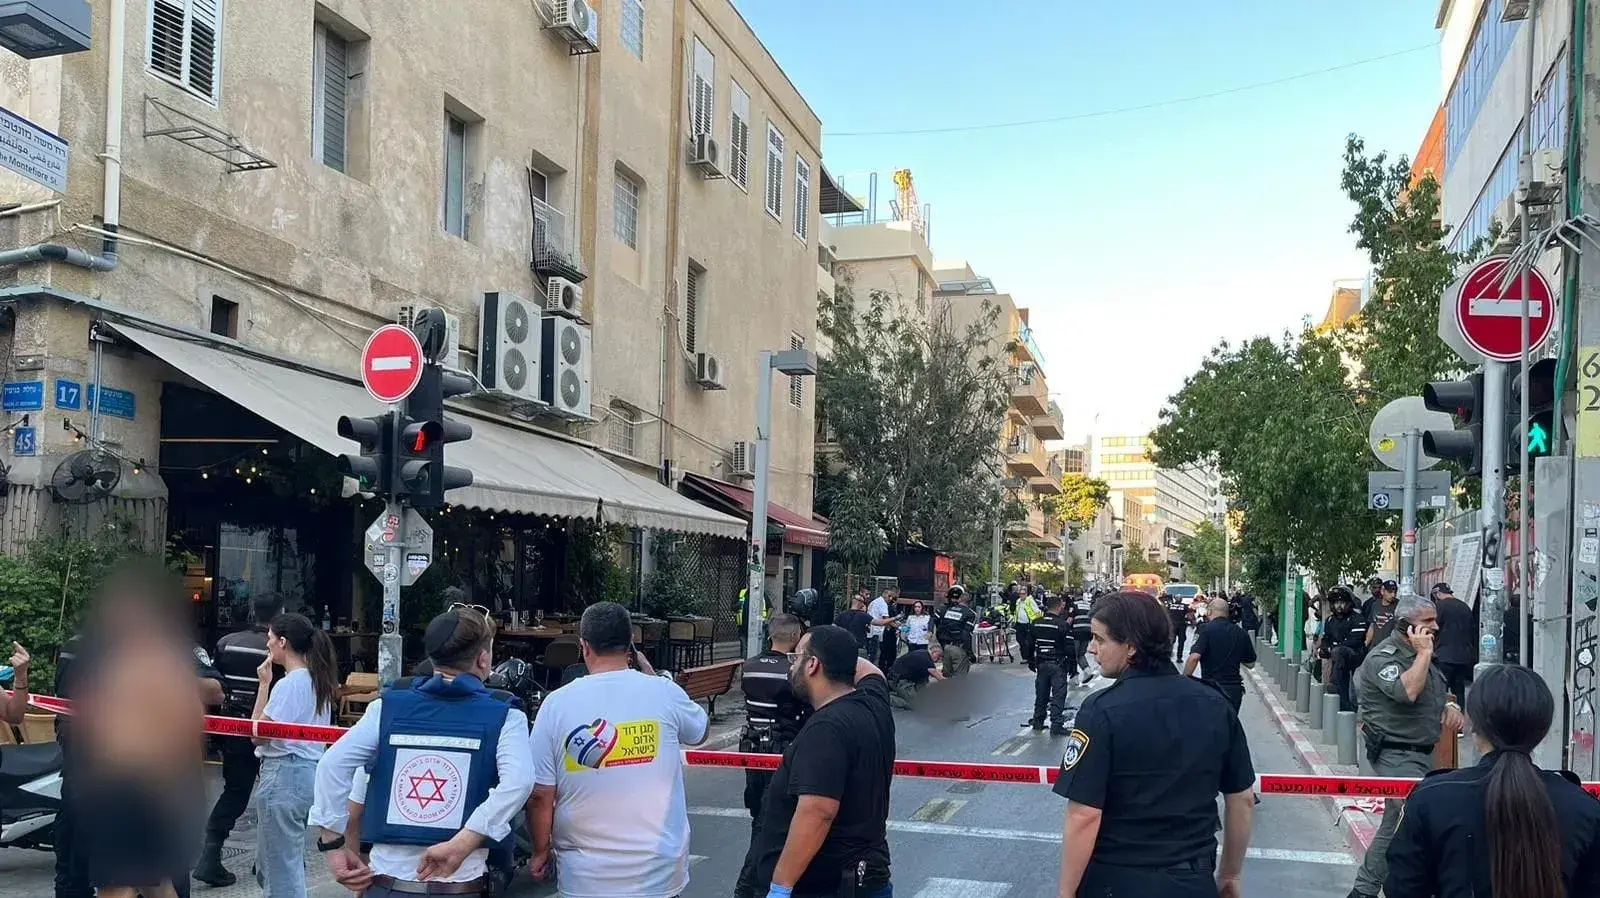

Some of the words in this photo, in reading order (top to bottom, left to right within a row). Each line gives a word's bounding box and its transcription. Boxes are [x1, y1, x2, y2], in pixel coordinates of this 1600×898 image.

[34, 135, 53, 151] משה
[9, 155, 48, 181] Montefiore
[58, 386, 79, 404] 17
[16, 433, 32, 450] 45
[622, 725, 638, 736] דוד
[639, 724, 654, 735] מגן
[633, 735, 655, 745] אדום
[622, 745, 655, 757] בישראל
[1267, 781, 1304, 792] מעבר
[1310, 782, 1328, 794] אין
[1353, 783, 1400, 795] ישראל
